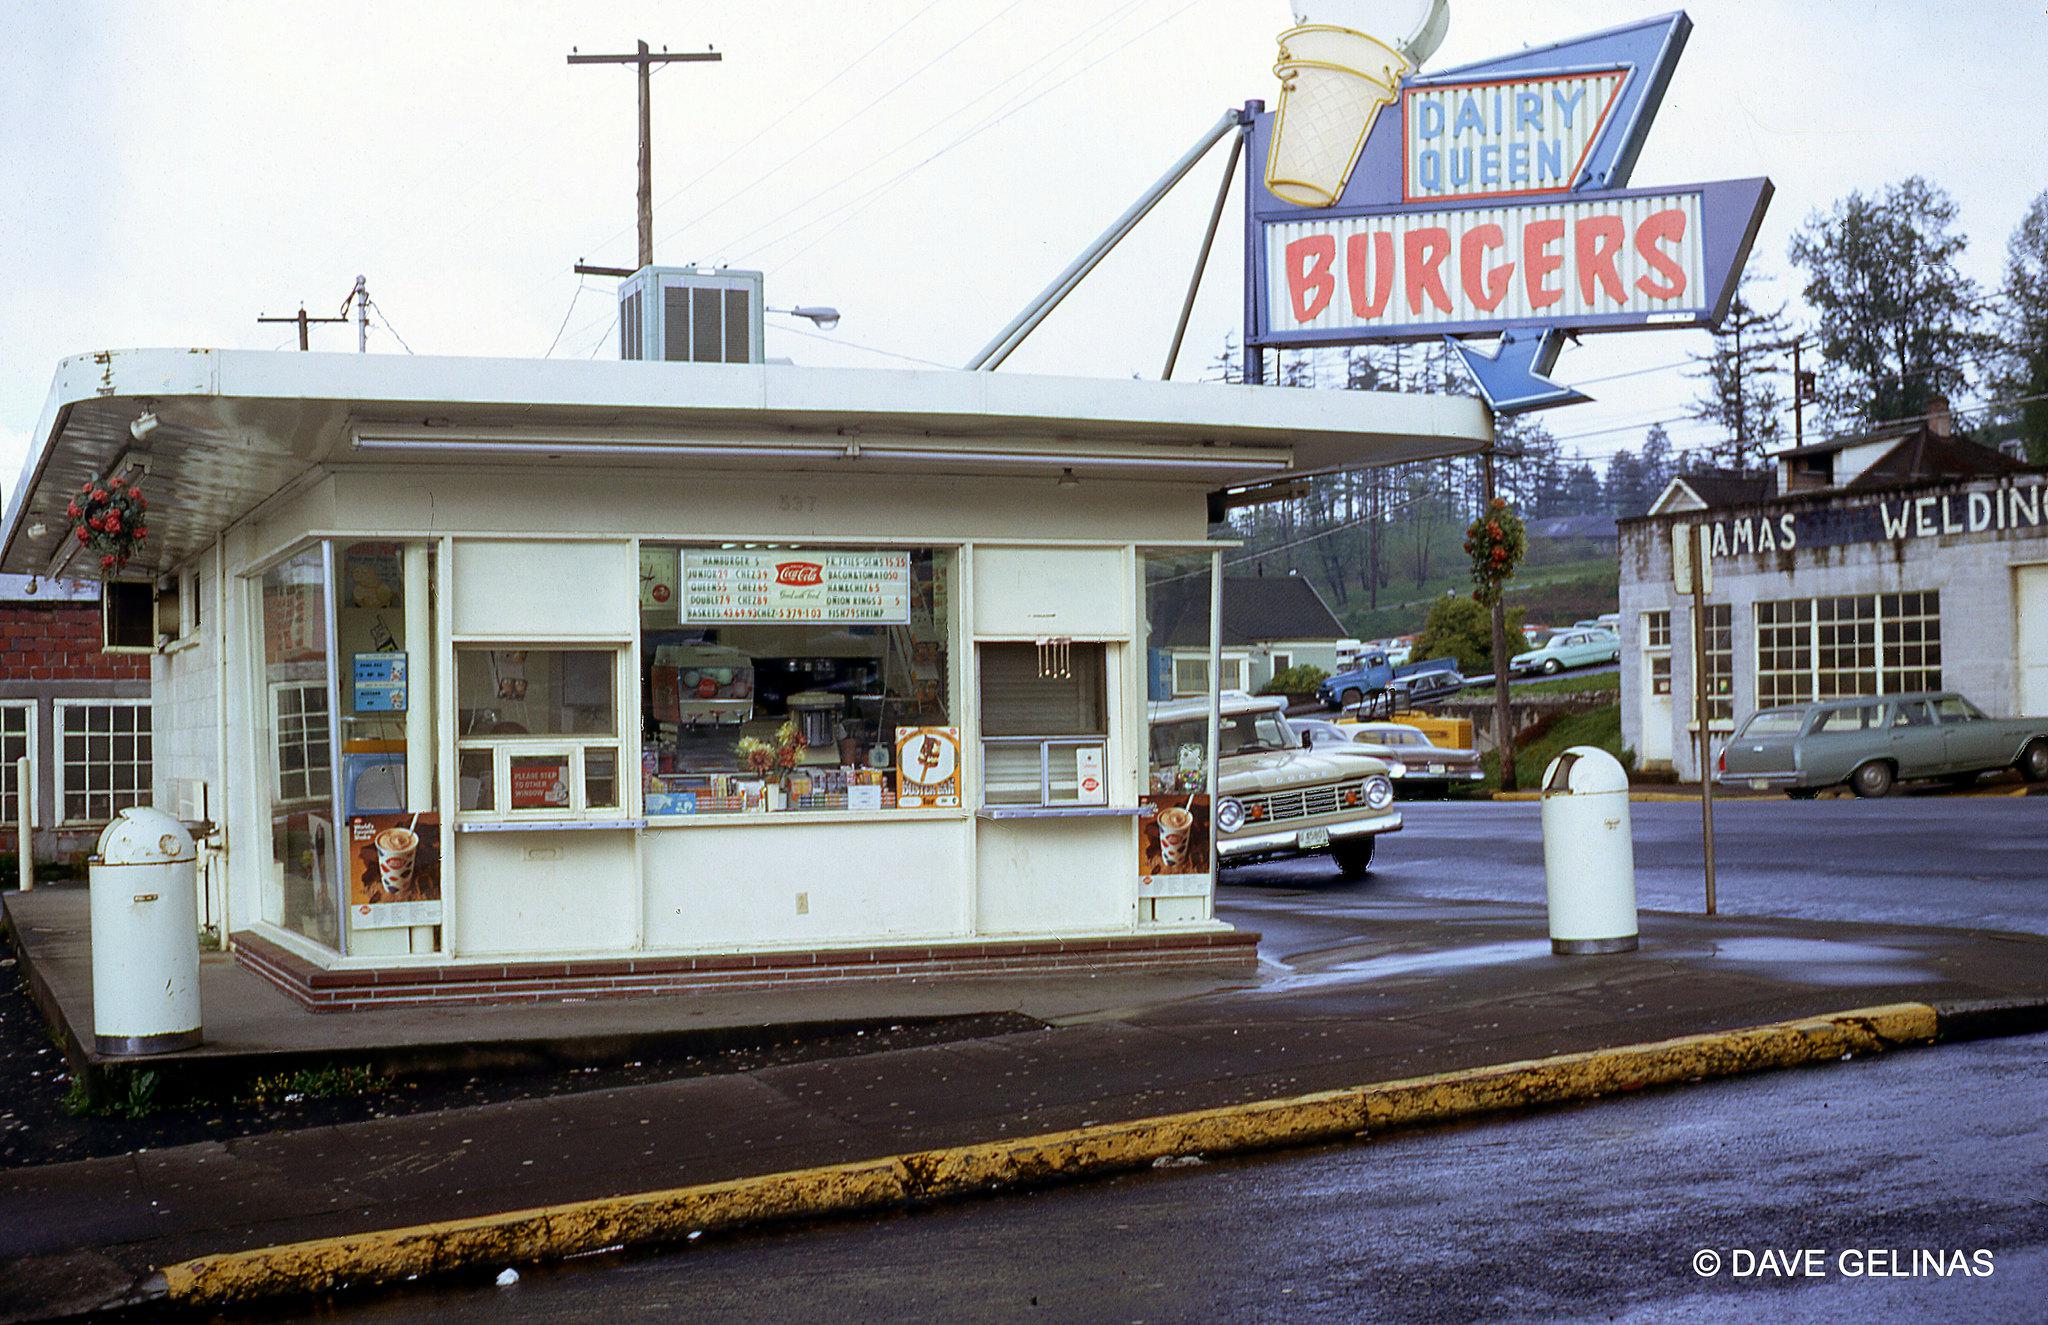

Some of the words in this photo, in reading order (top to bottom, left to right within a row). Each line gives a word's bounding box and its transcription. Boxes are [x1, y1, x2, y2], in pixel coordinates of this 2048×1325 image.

[1419, 86, 1586, 140] DAIRY
[1418, 140, 1563, 192] QUEEN
[1285, 208, 1687, 324] BURGERS
[780, 565, 818, 583] Coca-Cola
